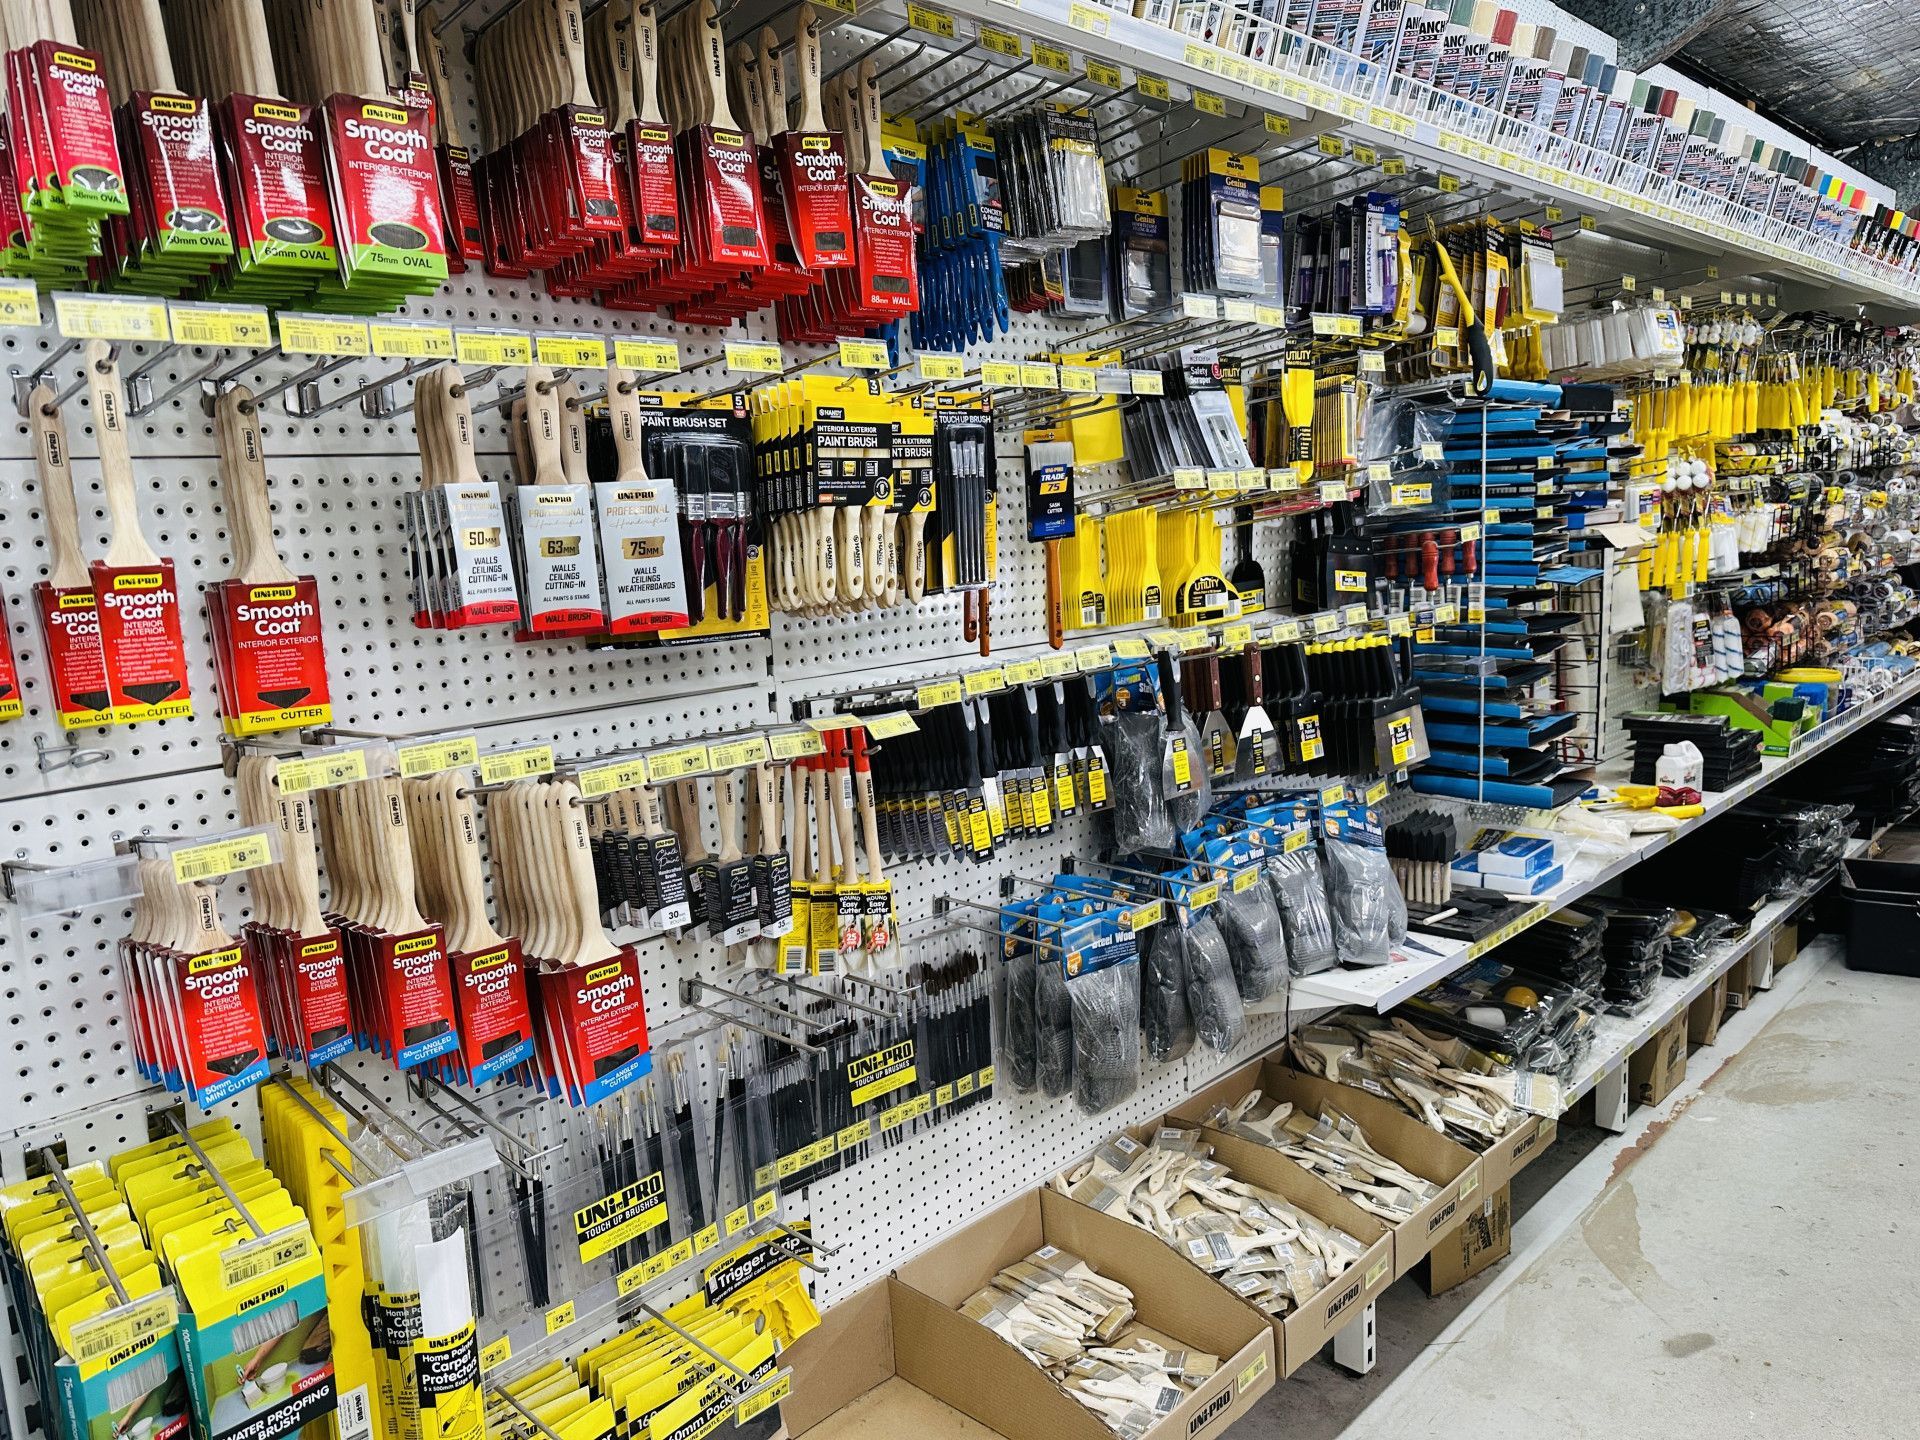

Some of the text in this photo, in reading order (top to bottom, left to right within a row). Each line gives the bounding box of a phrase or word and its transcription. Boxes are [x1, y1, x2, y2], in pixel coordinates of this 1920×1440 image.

[345, 118, 428, 150] Smooth
[365, 141, 415, 164] Coat
[1226, 177, 1246, 188] Genius
[1134, 214, 1156, 224] Genius
[370, 252, 432, 269] 75mm OVAL
[722, 248, 761, 259] 63mm WALL
[892, 296, 912, 306] WALL
[1285, 350, 1311, 360] UTILITY
[642, 417, 727, 428] PAINT BRUSH SET
[970, 416, 991, 424] BRUSH
[818, 436, 878, 448] PAINT BRUSH
[904, 448, 932, 457] BRUSH
[1042, 470, 1066, 482] TRADE
[1048, 482, 1060, 492] 75
[474, 556, 498, 565] WALLS
[552, 564, 576, 572] WALLS
[472, 564, 502, 575] CEILINGS
[549, 572, 580, 581] CEILINGS
[634, 566, 657, 576] WALLS
[468, 572, 508, 584] CUTTING-IN
[544, 580, 586, 590] CUTTING-IN
[632, 574, 660, 584] CEILINGS
[1194, 579, 1220, 591] UTILITY
[618, 582, 676, 593] WEATHERBOARDS
[104, 590, 175, 608] Smooth
[120, 603, 164, 620] Coat
[238, 602, 314, 622] Smooth
[470, 604, 514, 616] WALL BRUSH
[546, 612, 592, 624] WALL BRUSH
[629, 614, 673, 626] WALL BRUSH
[254, 618, 302, 636] Coat
[119, 704, 190, 720] 50mm CUTTER
[249, 708, 323, 724] 75mm CUTTER
[448, 750, 468, 761] $8.99
[330, 766, 353, 778] $6.99
[234, 848, 258, 862] $8.99
[1234, 848, 1264, 866] Steel Wool
[839, 907, 862, 916] Cutter
[842, 901, 858, 910] Easy
[866, 906, 890, 916] Cutter
[870, 900, 886, 910] Easy
[298, 954, 343, 973] Smooth
[392, 950, 442, 970] Smooth
[185, 965, 249, 991] Smooth
[309, 966, 338, 980] Coat
[404, 963, 434, 978] Coat
[465, 962, 516, 987] Smooth
[200, 980, 240, 1000] Coat
[478, 978, 510, 995] Coat
[577, 974, 634, 1004] Smooth
[592, 992, 626, 1013] Coat
[320, 1046, 346, 1061] CUTTER
[414, 1044, 443, 1060] CUTTER
[492, 1056, 518, 1072] CUTTER
[614, 1061, 639, 1078] ANGLED
[610, 1070, 633, 1088] CUTTER
[855, 1074, 875, 1088] TOUCH
[876, 1070, 886, 1081] UP
[887, 1060, 910, 1078] BRUSHES
[204, 1080, 233, 1096] 50mm
[205, 1070, 263, 1104] MINI CUTTER
[585, 1221, 612, 1240] TOUCH
[613, 1214, 623, 1226] UP
[626, 1196, 659, 1220] BRUSHES
[276, 1242, 304, 1261] 16.99
[718, 1237, 801, 1288] Trigger Grip
[135, 1311, 166, 1331] 14.99
[422, 1352, 450, 1363] Home
[432, 1350, 472, 1373] Carpet
[422, 1356, 477, 1385] Protectors
[433, 1384, 454, 1392] 500mm
[455, 1378, 468, 1388] Edge
[221, 1385, 330, 1440] WATER PROOFING
[258, 1413, 300, 1440] BRUSH
